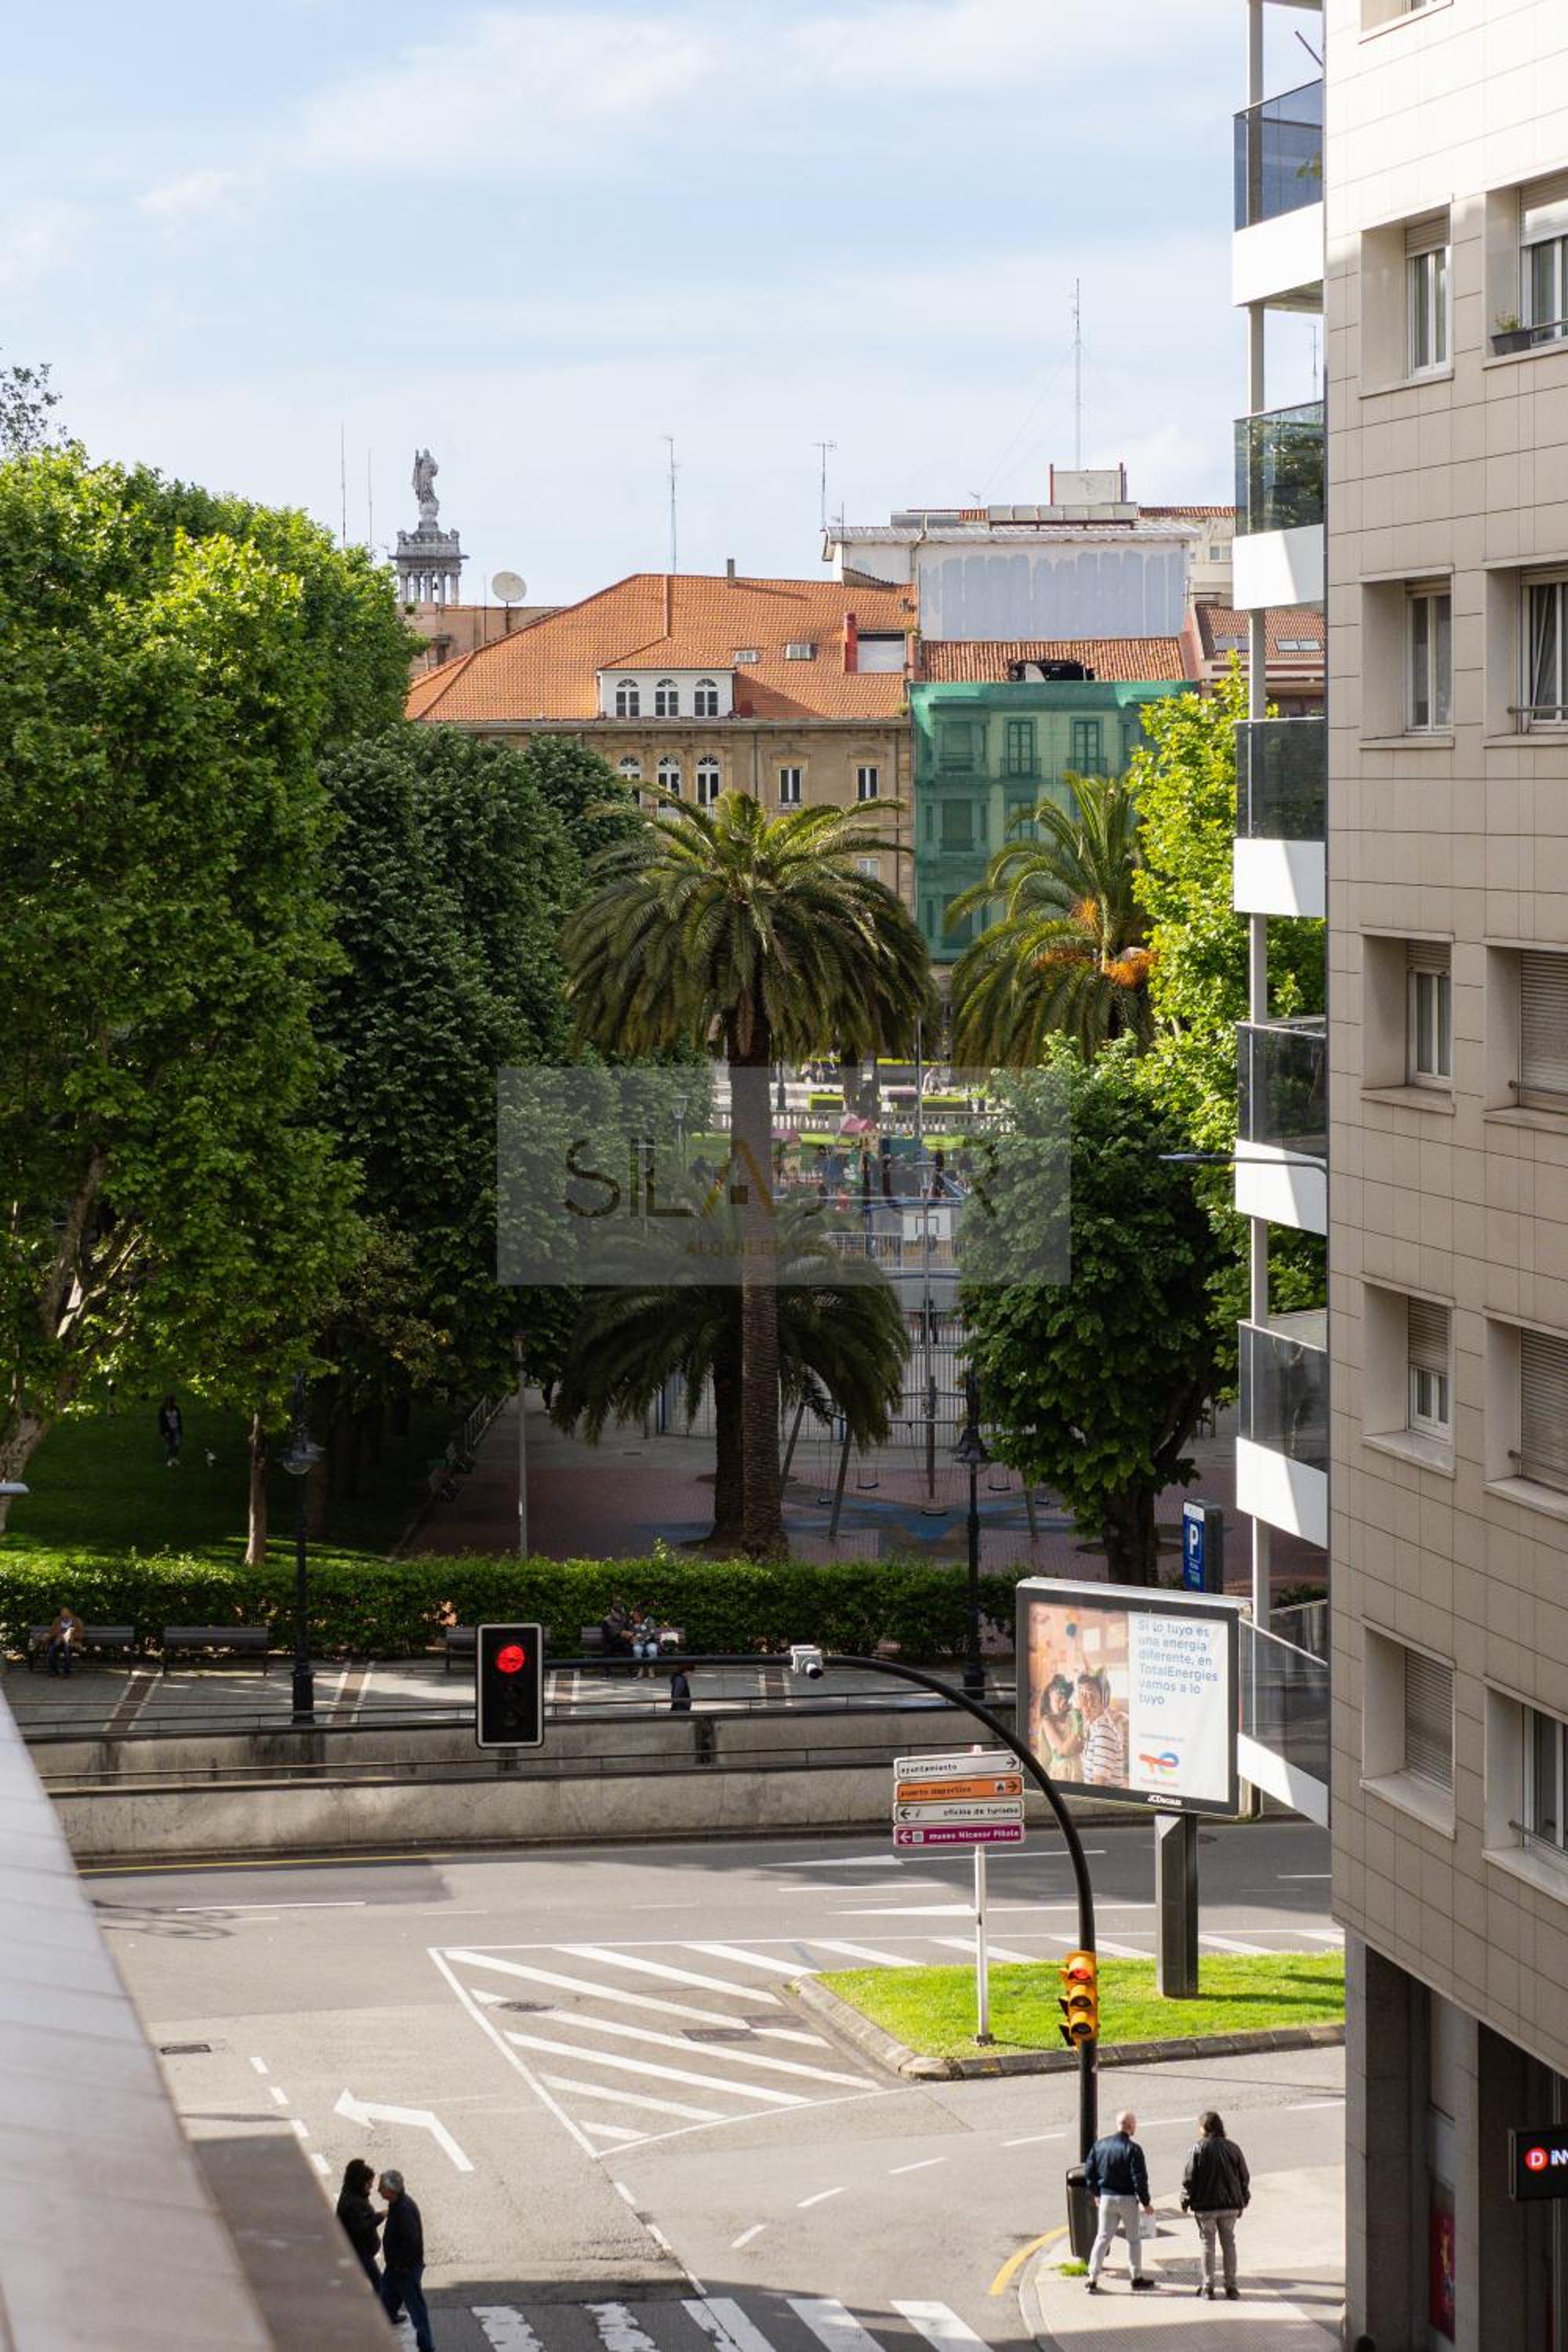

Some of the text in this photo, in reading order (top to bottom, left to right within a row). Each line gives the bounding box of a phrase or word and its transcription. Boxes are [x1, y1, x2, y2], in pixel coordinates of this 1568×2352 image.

[1189, 1523, 1199, 1555] P
[1167, 1623, 1192, 1635] tuyo
[1196, 1628, 1210, 1637] es
[1138, 1636, 1160, 1646] una
[1197, 1657, 1212, 1666] en
[1140, 1663, 1218, 1682] TotalEnergies
[1140, 1681, 1201, 1694] vamos a lo
[1139, 1693, 1165, 1705] tuyo
[901, 1764, 957, 1774] ayuntamiento
